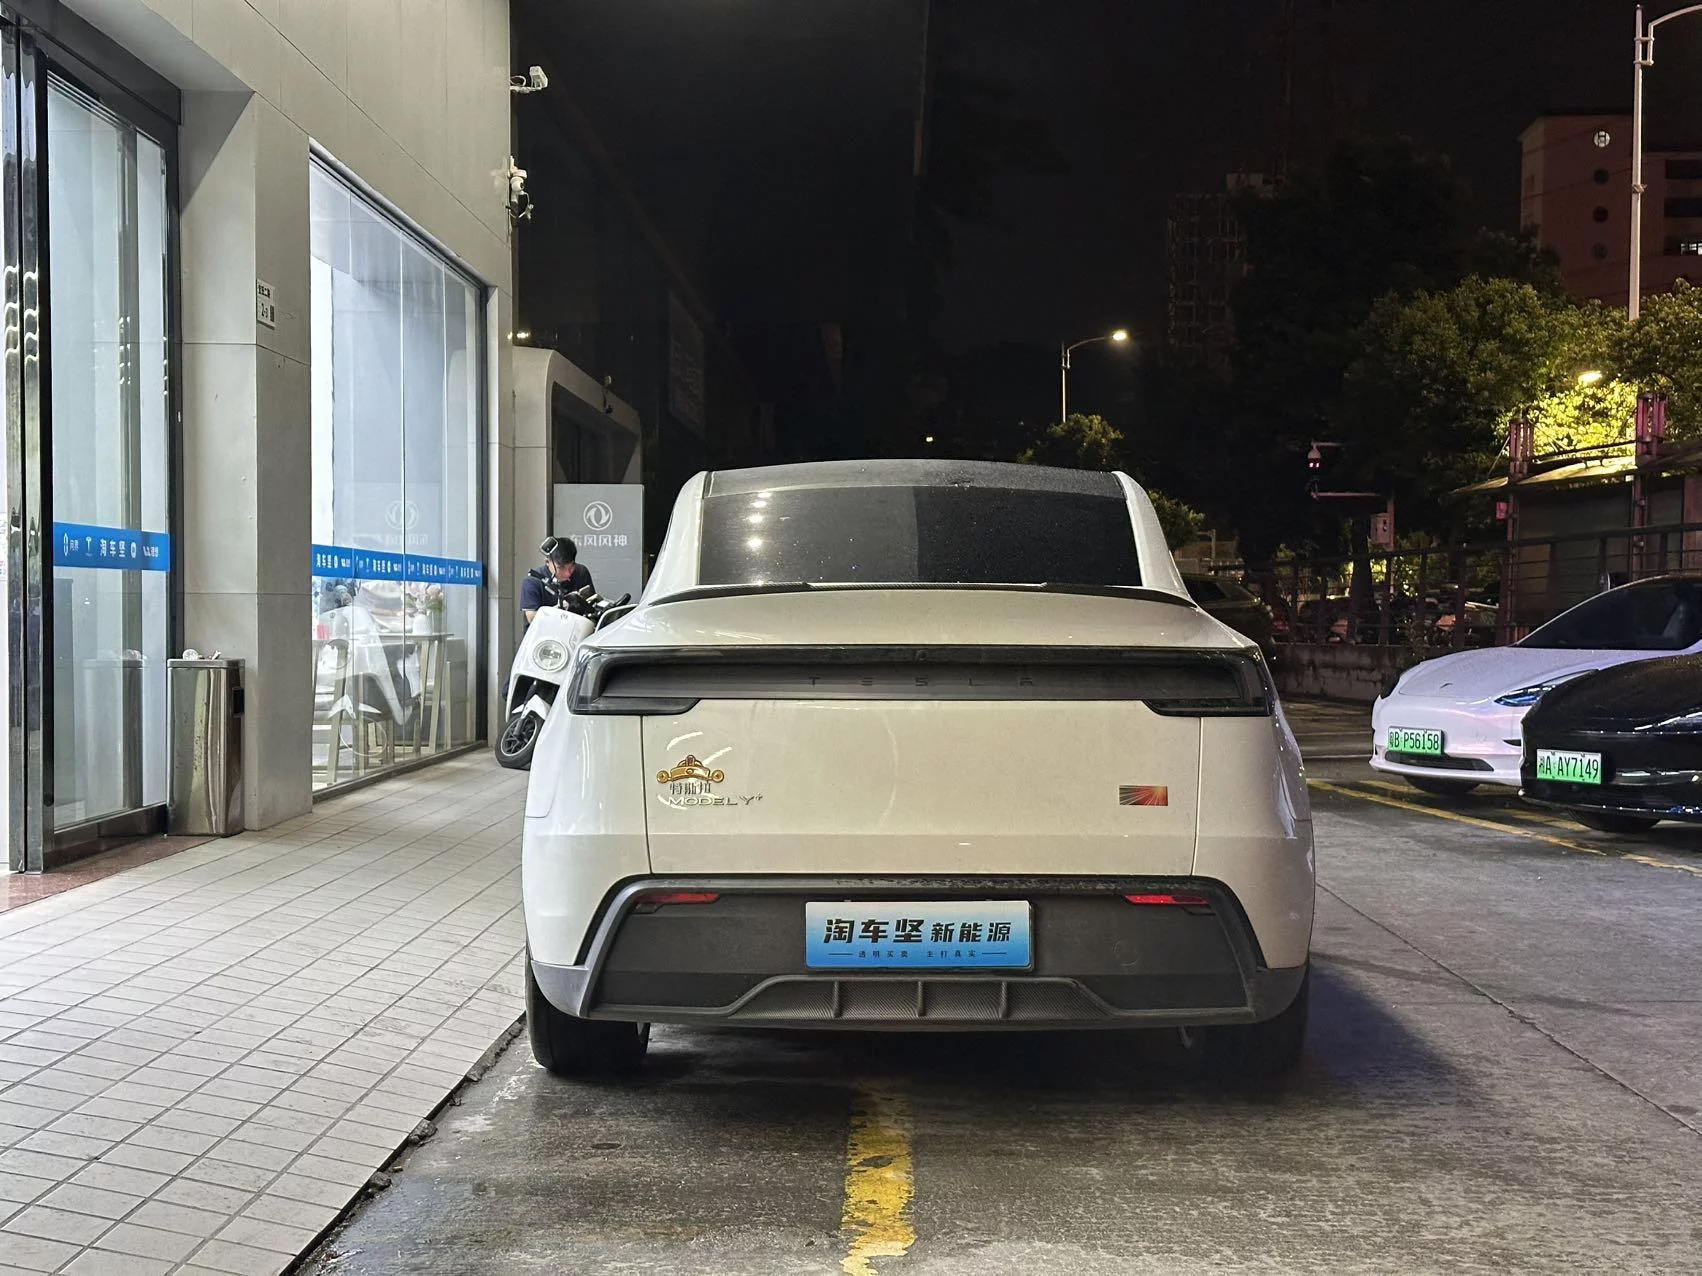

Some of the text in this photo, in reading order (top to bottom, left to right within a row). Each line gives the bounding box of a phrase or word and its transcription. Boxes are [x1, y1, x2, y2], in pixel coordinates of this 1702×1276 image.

[571, 534, 628, 546] 东风风神
[808, 676, 1034, 687] TESLA
[668, 795, 738, 806] MODEL
